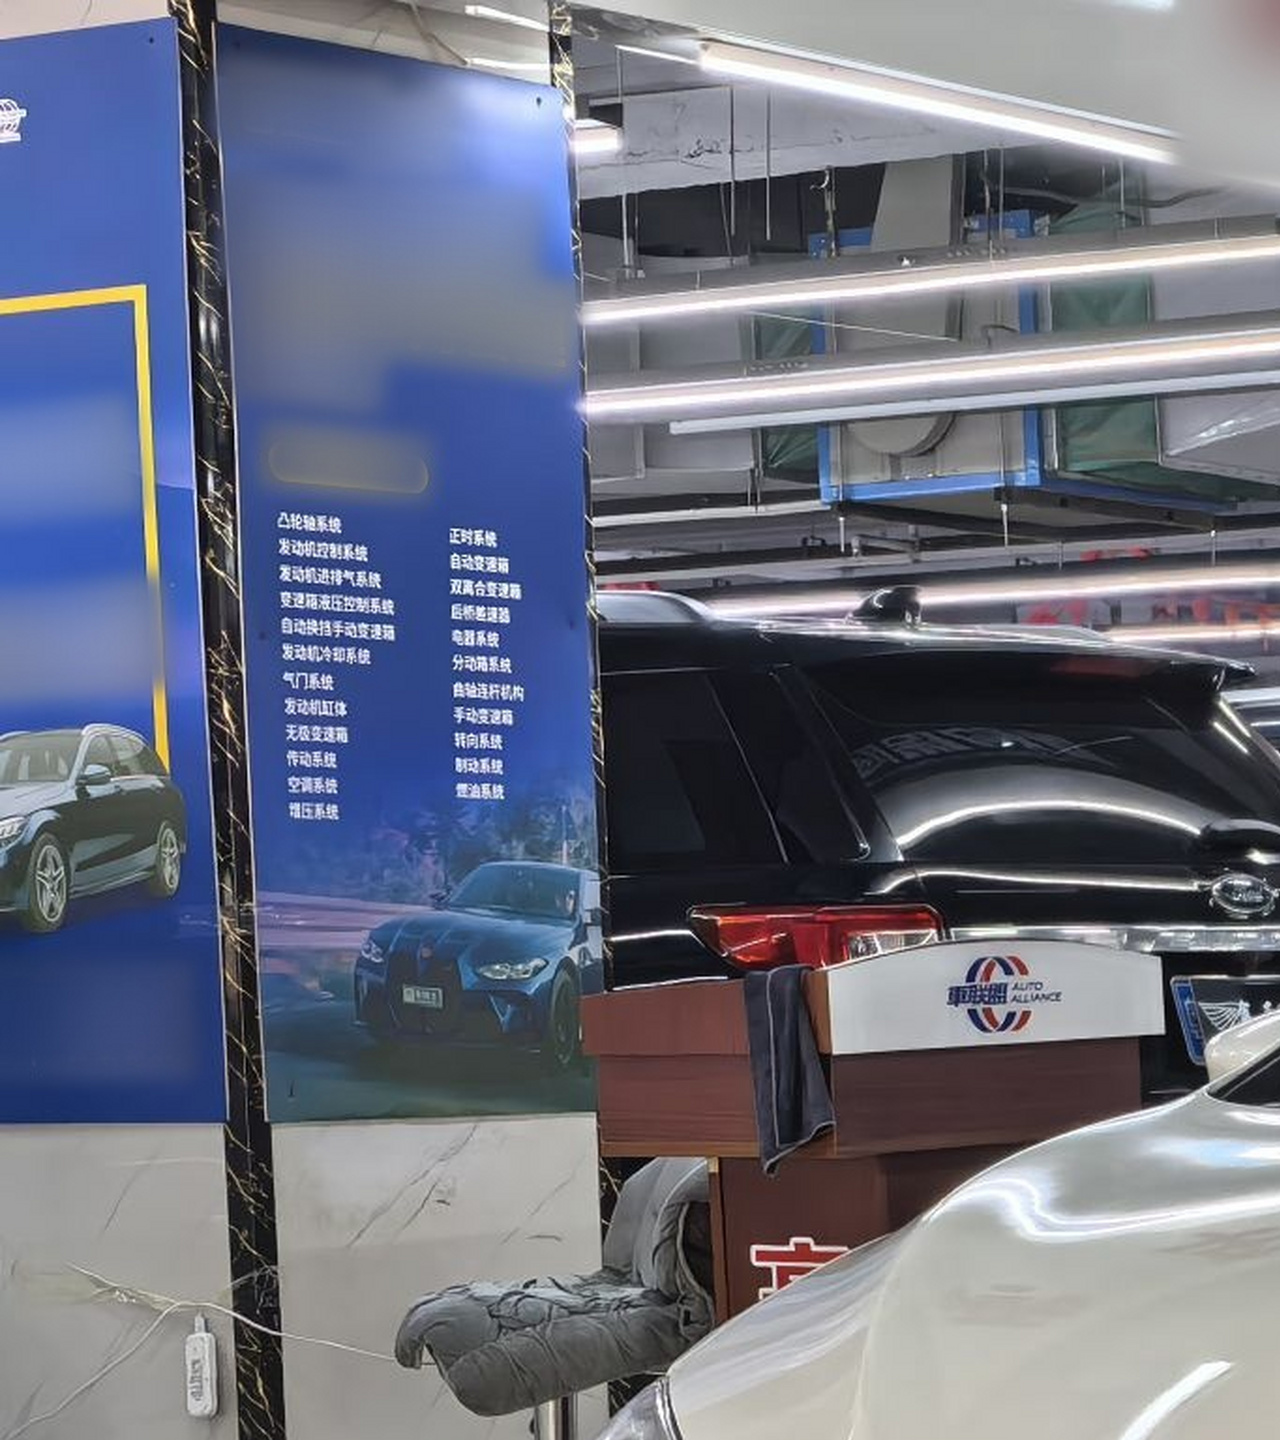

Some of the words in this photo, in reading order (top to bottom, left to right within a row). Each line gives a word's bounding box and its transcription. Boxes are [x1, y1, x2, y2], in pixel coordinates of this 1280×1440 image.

[277, 512, 342, 533] 凸轮轴系统
[450, 528, 498, 547] 正时系统
[450, 553, 510, 574] 自动变速箱
[282, 672, 334, 690] 气门系统
[284, 697, 348, 716] 发动机缸体
[454, 706, 514, 726] 手动变速箱
[454, 732, 503, 750] 转向系统
[286, 750, 337, 768] 传动系统
[287, 776, 338, 794] 空调系统
[1012, 981, 1043, 992] AUTO
[1011, 992, 1062, 1004] ALLIANCE
